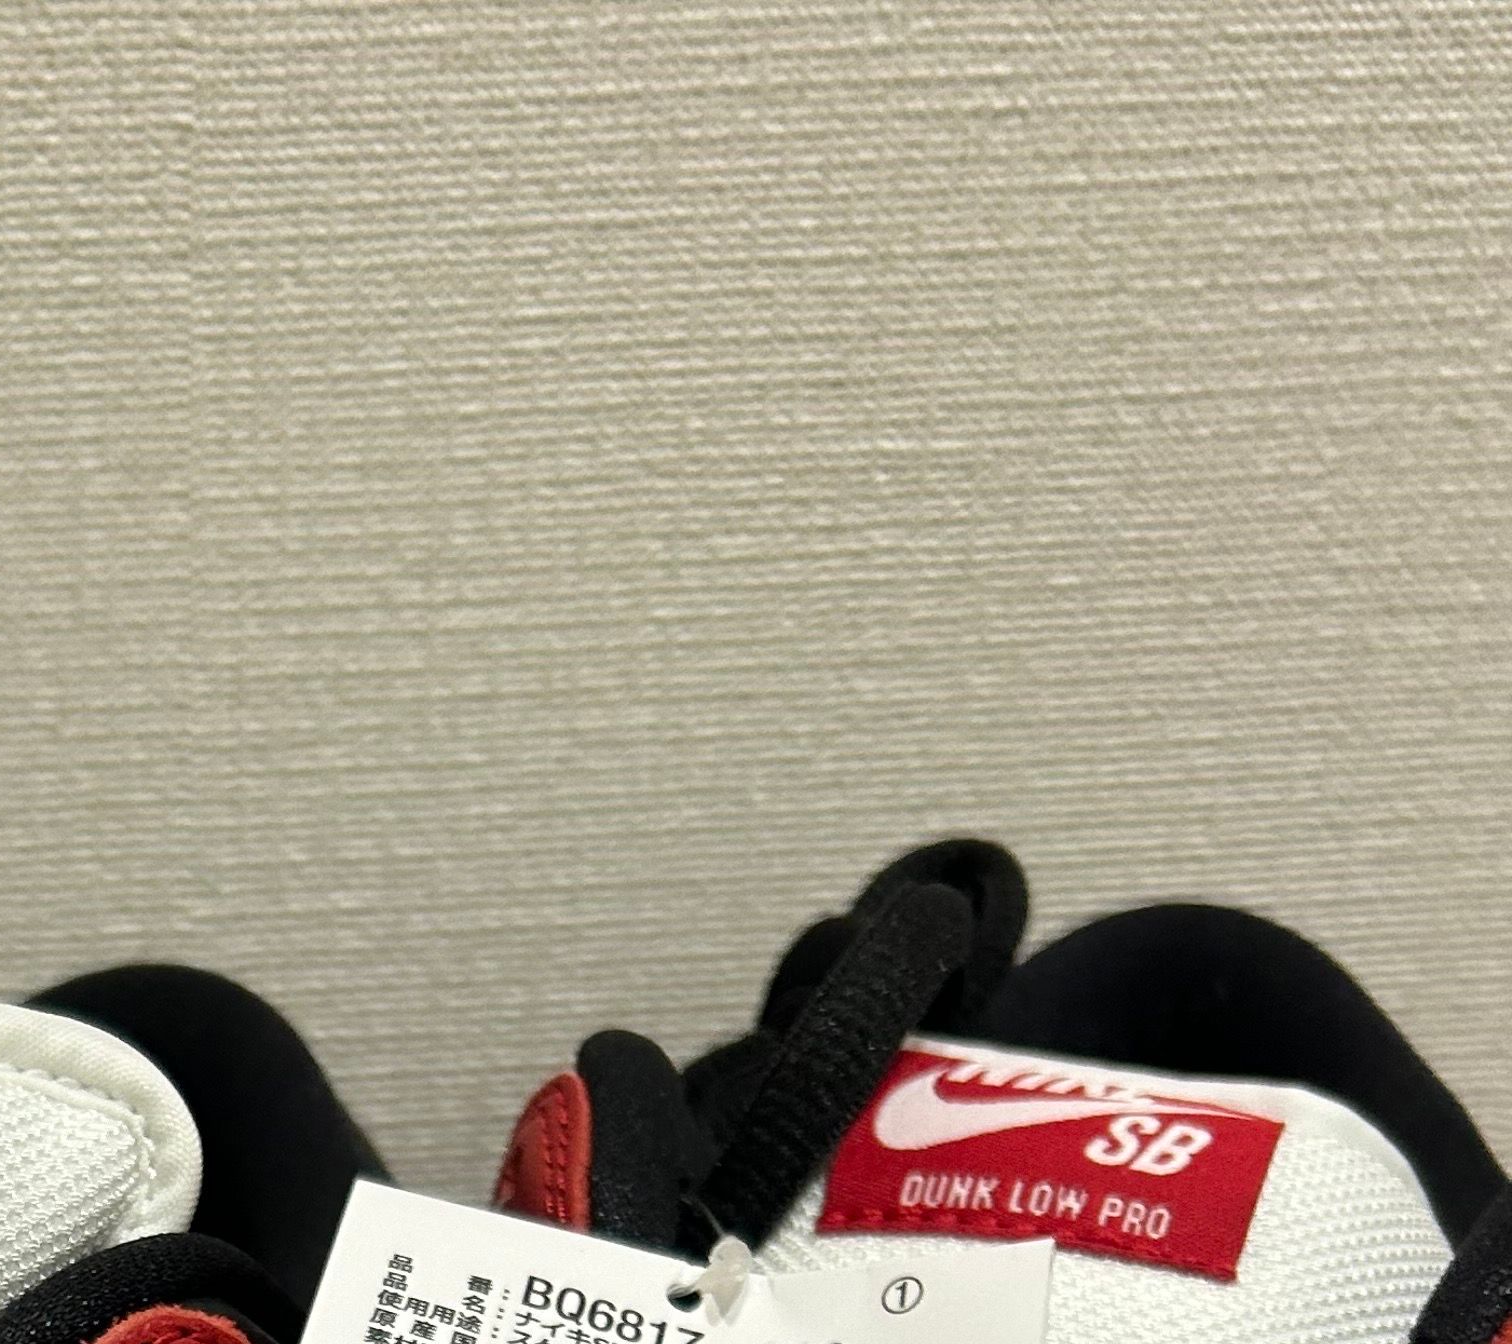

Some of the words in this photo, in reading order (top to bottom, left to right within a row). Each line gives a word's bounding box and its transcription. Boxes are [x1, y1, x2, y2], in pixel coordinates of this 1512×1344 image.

[1085, 1114, 1212, 1177] SB
[900, 1173, 998, 1210] DUNK
[1009, 1182, 1088, 1220] LOW
[1097, 1197, 1172, 1241] PRO
